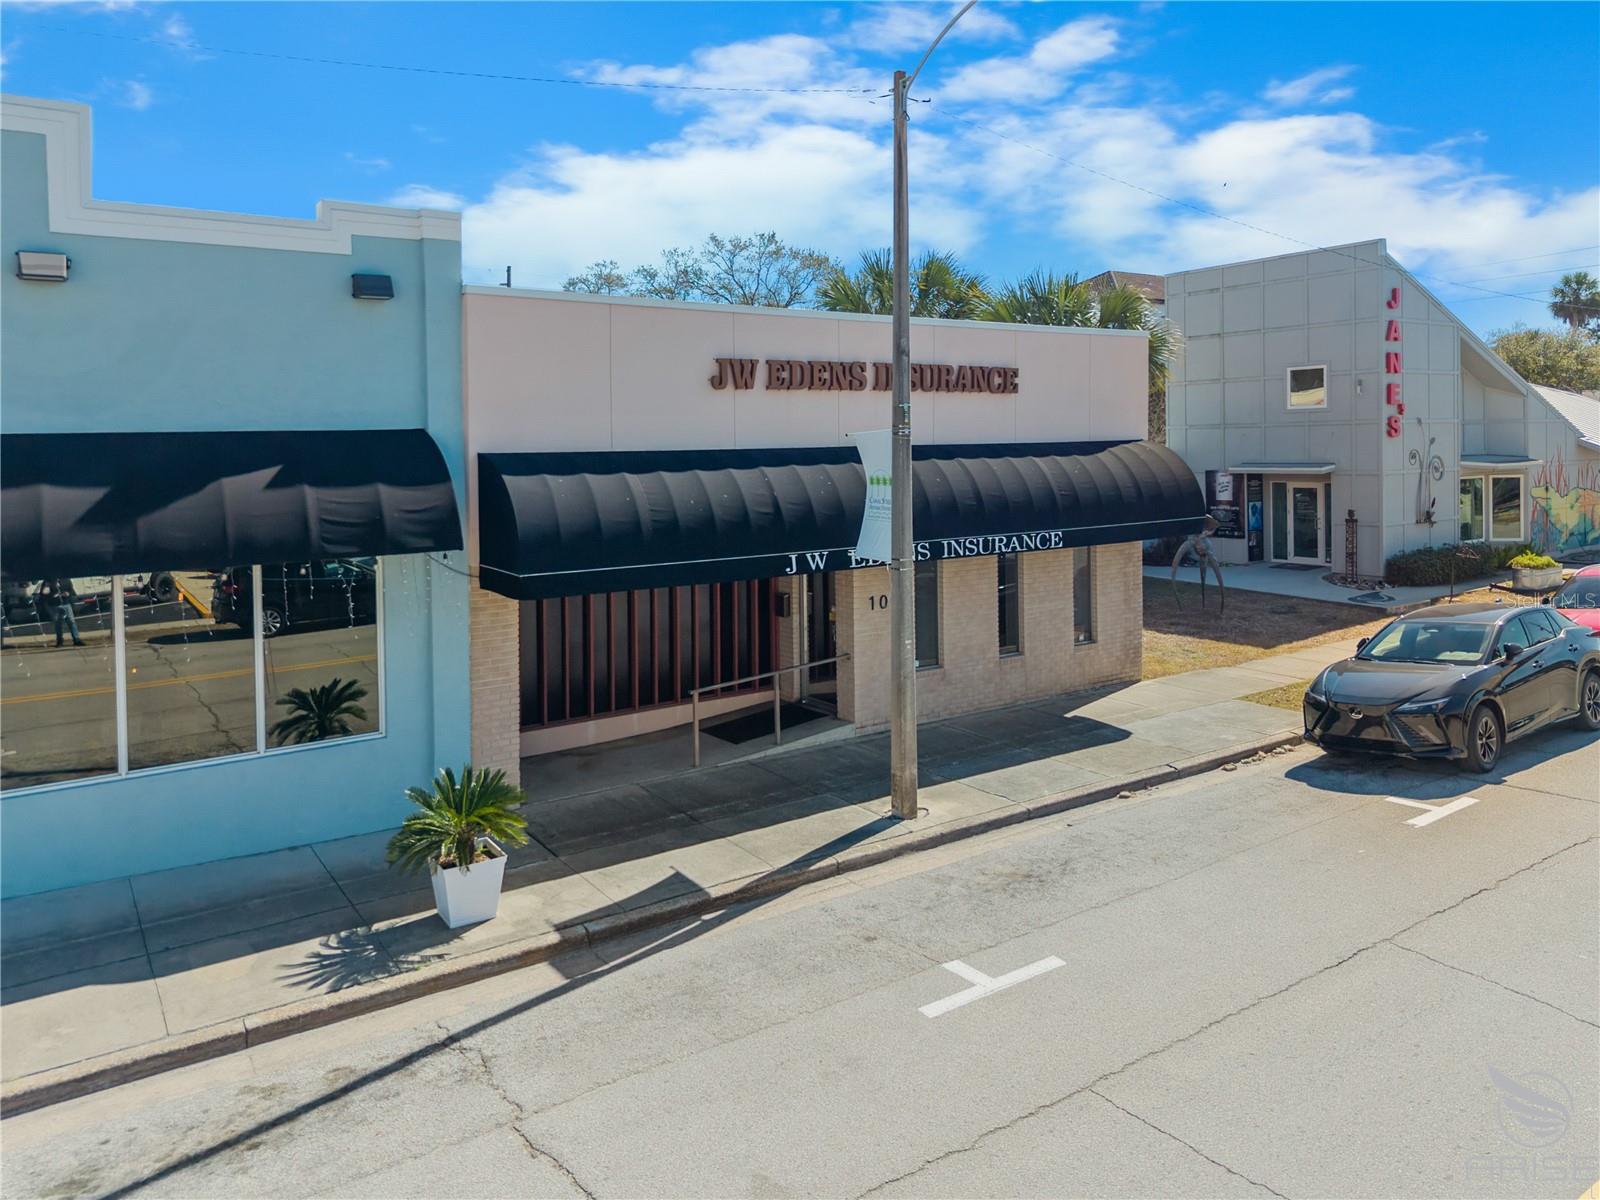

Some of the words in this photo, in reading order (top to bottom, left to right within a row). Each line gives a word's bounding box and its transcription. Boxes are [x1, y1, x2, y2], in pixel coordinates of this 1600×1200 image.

[710, 358, 759, 390] JW
[765, 360, 867, 391] EDENS
[872, 362, 1019, 394] ISURANCE
[942, 532, 1063, 558] INSURANCE
